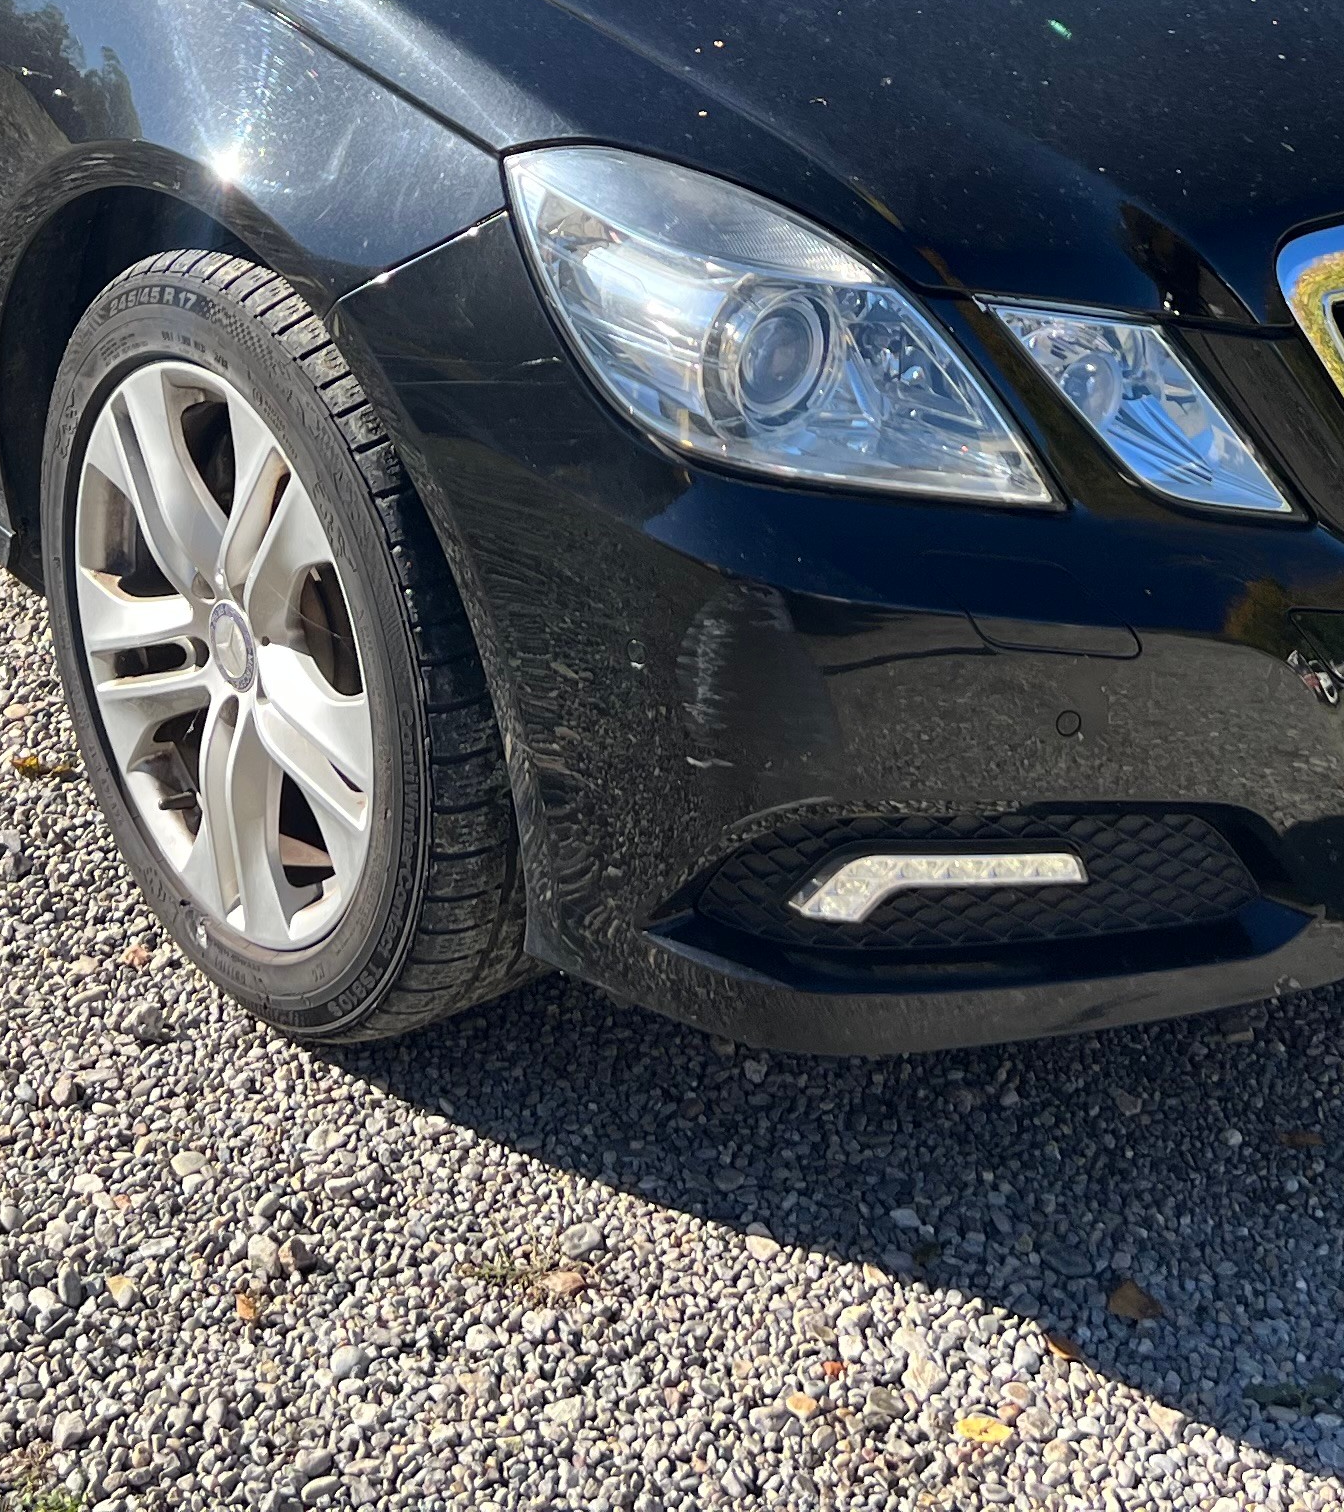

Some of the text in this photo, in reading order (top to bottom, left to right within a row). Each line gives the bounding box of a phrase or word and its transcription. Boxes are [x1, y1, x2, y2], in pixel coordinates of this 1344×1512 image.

[108, 287, 197, 317] 245/45 R 17
